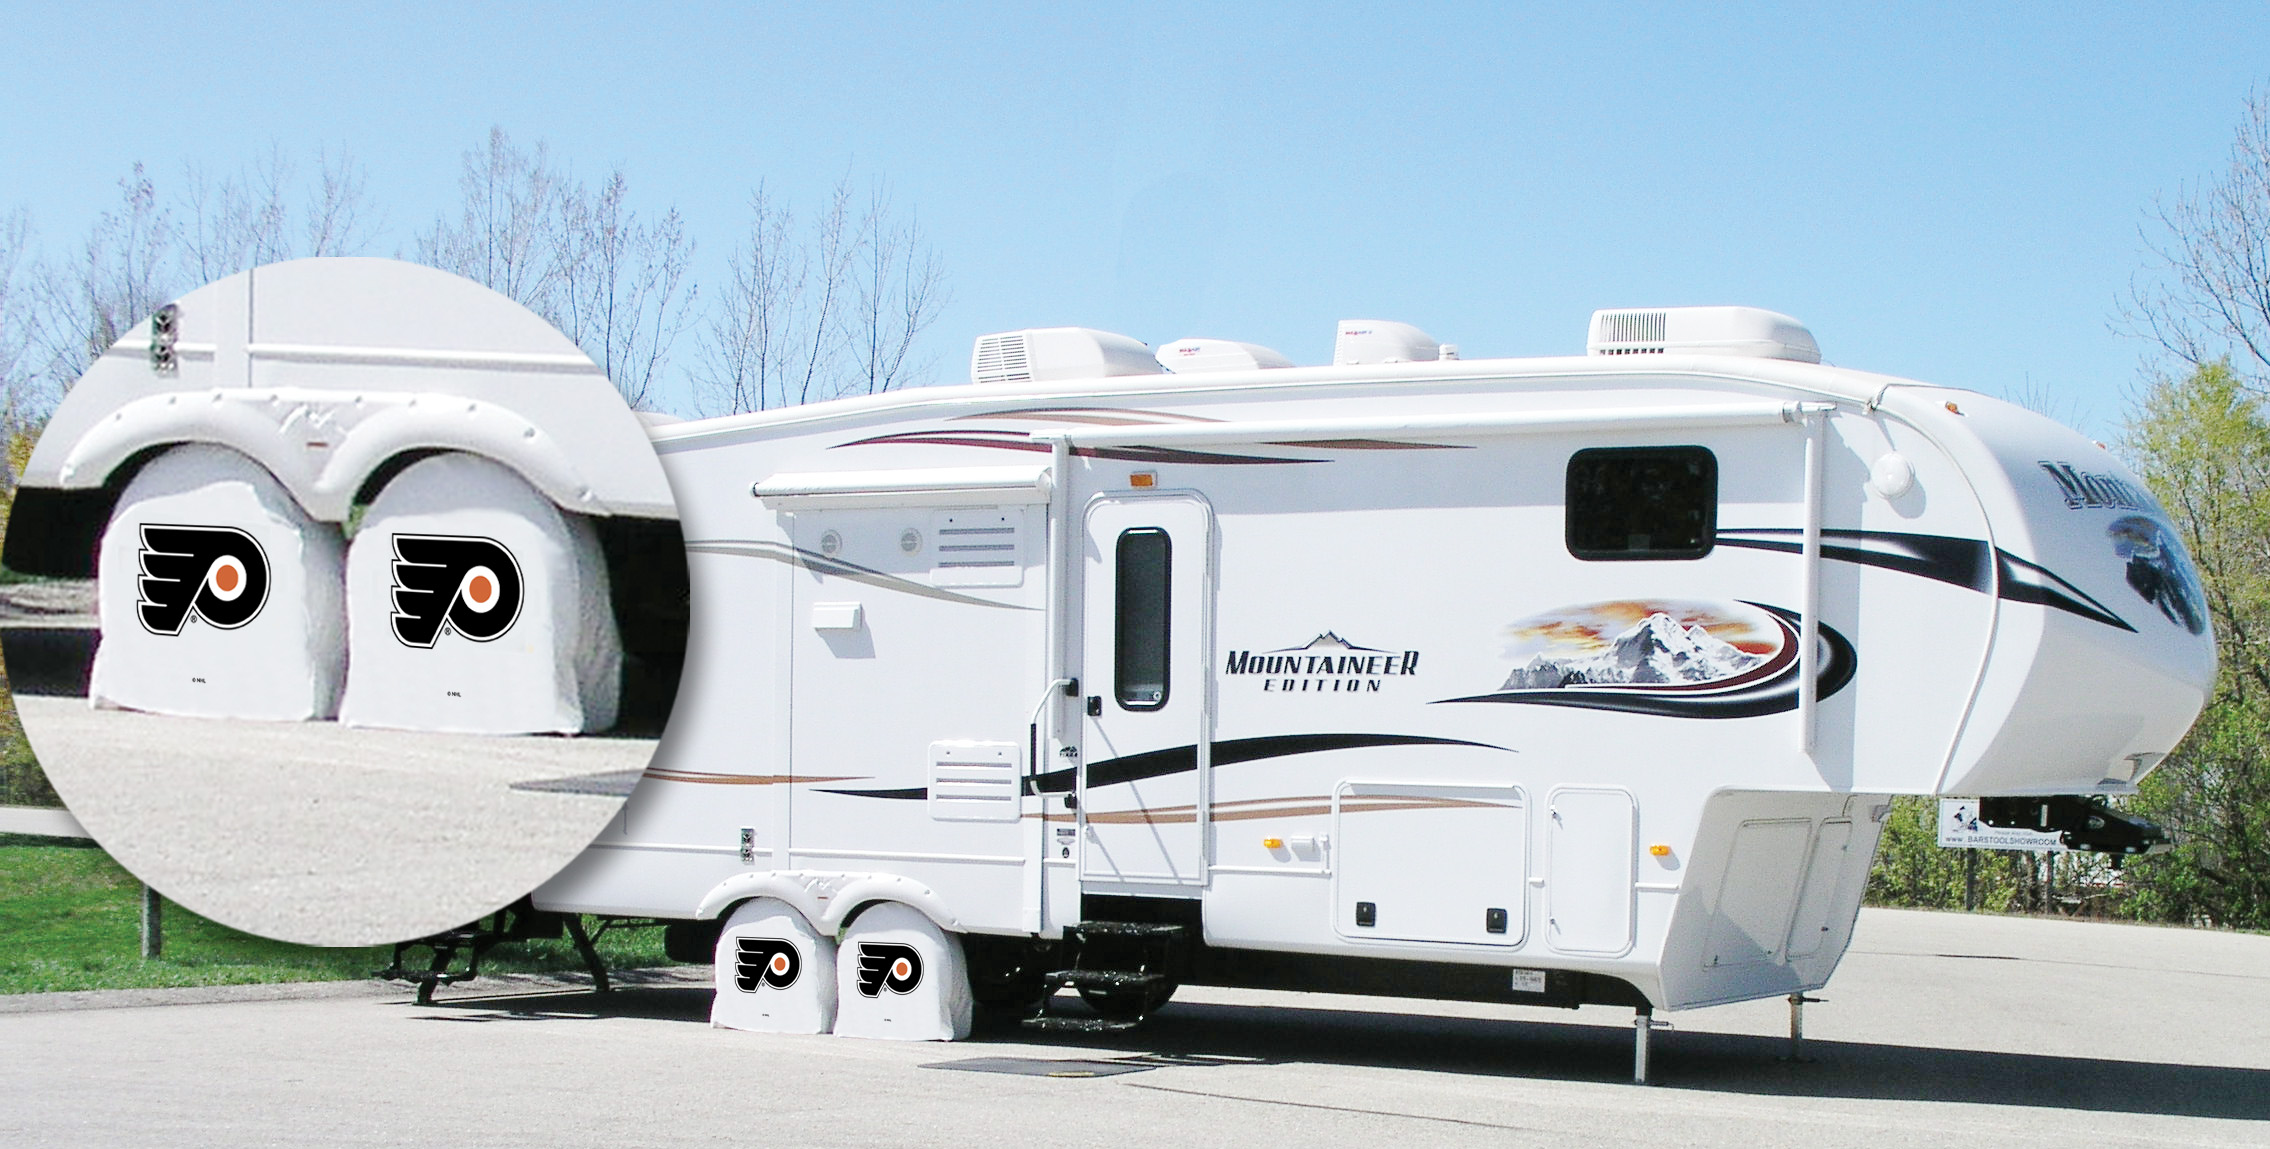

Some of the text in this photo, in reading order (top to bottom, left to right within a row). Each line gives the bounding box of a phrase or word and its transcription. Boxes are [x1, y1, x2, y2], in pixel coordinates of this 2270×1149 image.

[1225, 650, 1419, 676] MOUNTAINEER
[1263, 679, 1381, 692] EDITION
[1967, 835, 2057, 846] BARSTOOLSHOWROOM
